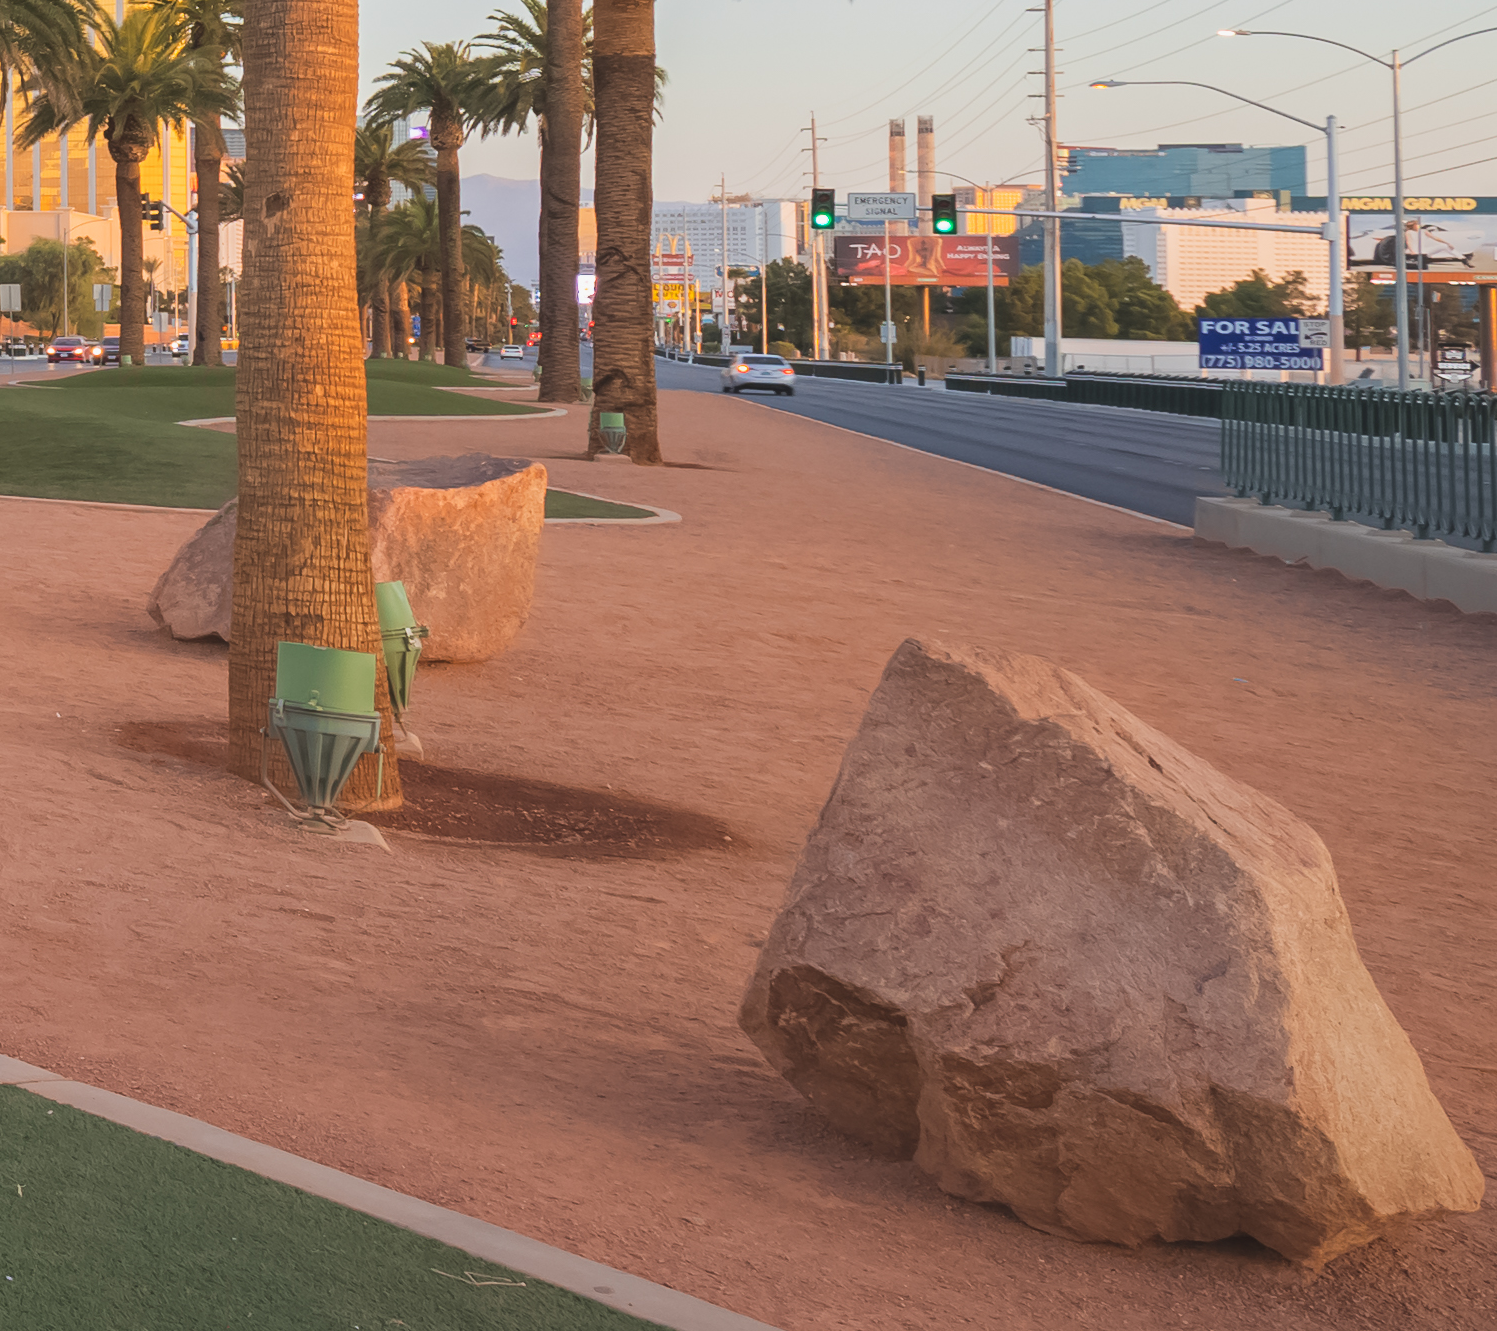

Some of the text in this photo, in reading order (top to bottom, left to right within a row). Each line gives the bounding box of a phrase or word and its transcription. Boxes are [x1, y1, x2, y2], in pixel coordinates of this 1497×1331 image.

[854, 196, 909, 205] EMERGENCY
[1340, 197, 1478, 211] MGM GRAND
[865, 207, 898, 216] SIGNAL
[849, 243, 902, 259] TAO
[1200, 320, 1300, 335] FOR SAL
[1237, 343, 1261, 352] 5.25
[1264, 343, 1301, 353] ACRES
[1201, 354, 1322, 369] (775) 980-5000
